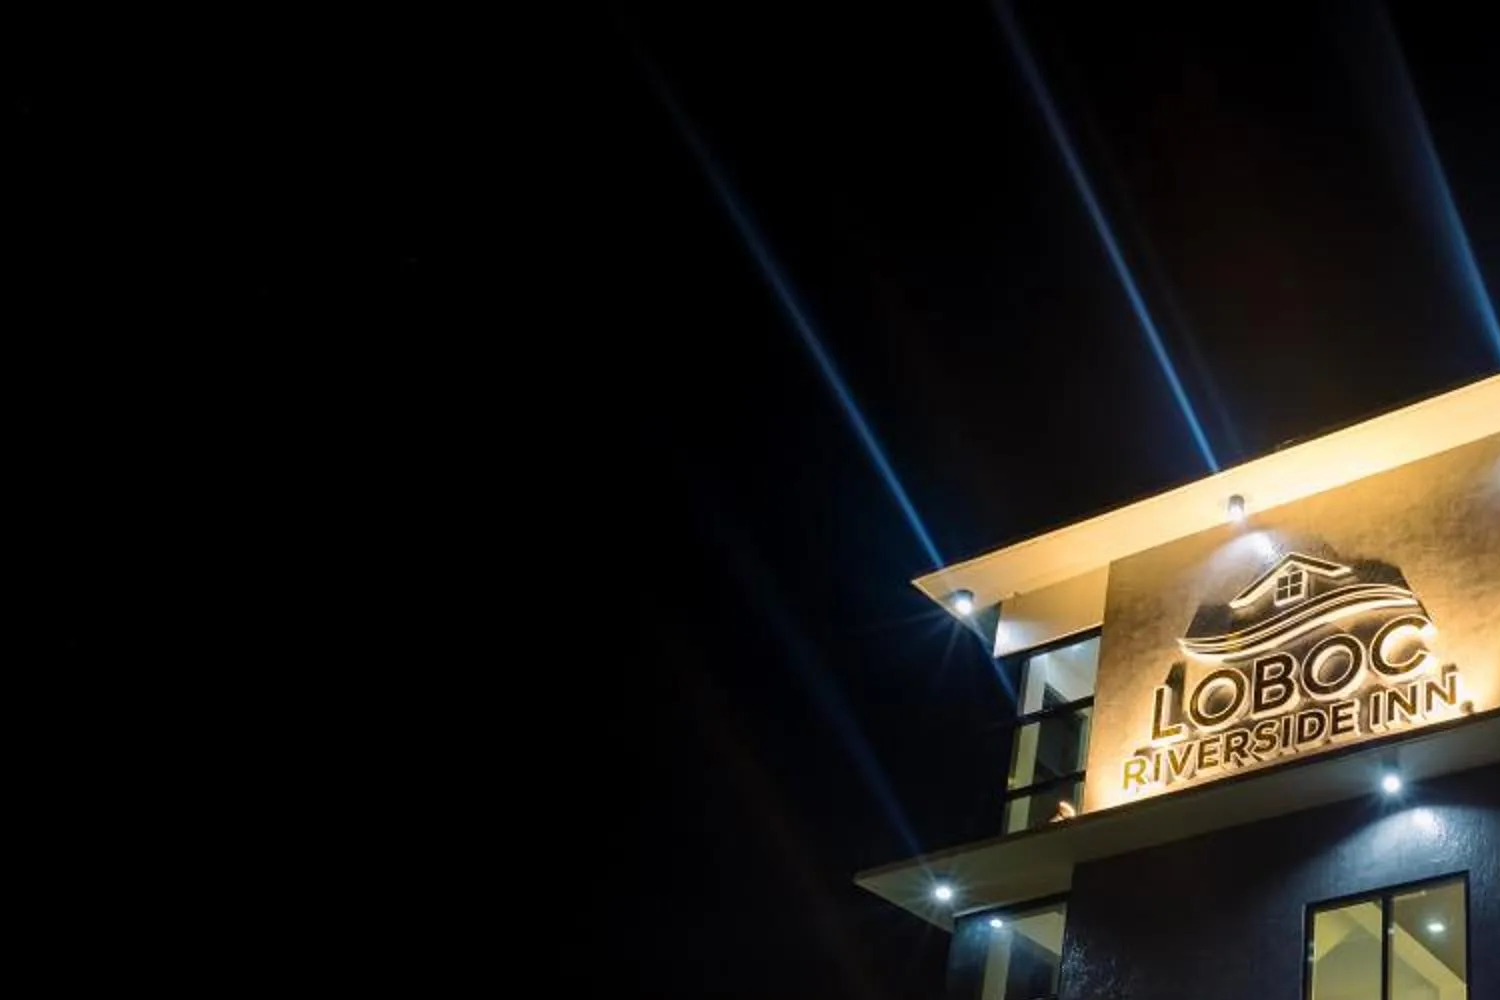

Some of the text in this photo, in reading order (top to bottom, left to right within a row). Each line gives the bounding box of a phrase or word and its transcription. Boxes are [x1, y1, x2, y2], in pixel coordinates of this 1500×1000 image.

[1121, 672, 1461, 790] RIVERSIDE INN
[1150, 613, 1433, 742] LOBOC
